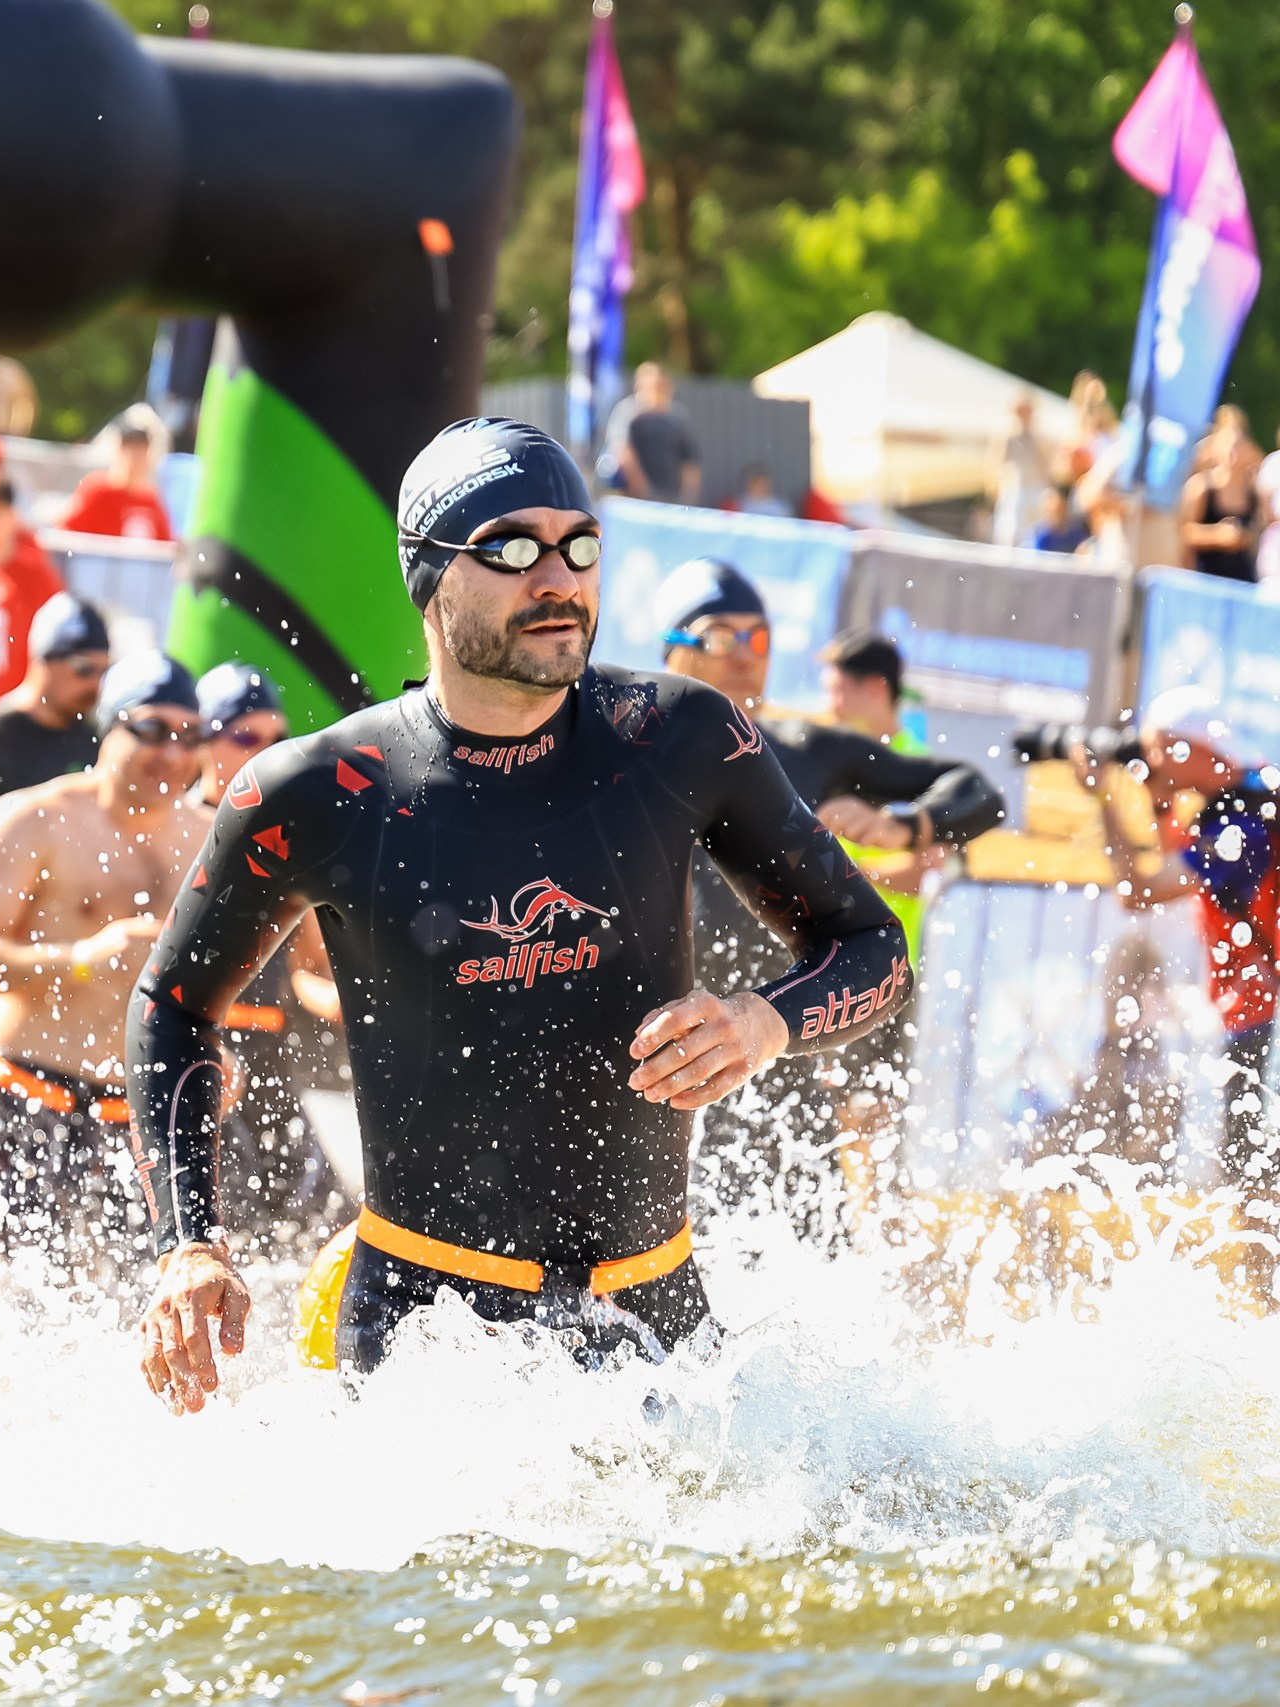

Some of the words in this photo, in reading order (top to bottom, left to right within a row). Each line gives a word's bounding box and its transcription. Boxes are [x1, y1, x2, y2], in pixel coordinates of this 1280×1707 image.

[453, 734, 555, 774] sailfish
[456, 936, 600, 989] sailfish
[800, 954, 907, 1040] attack
